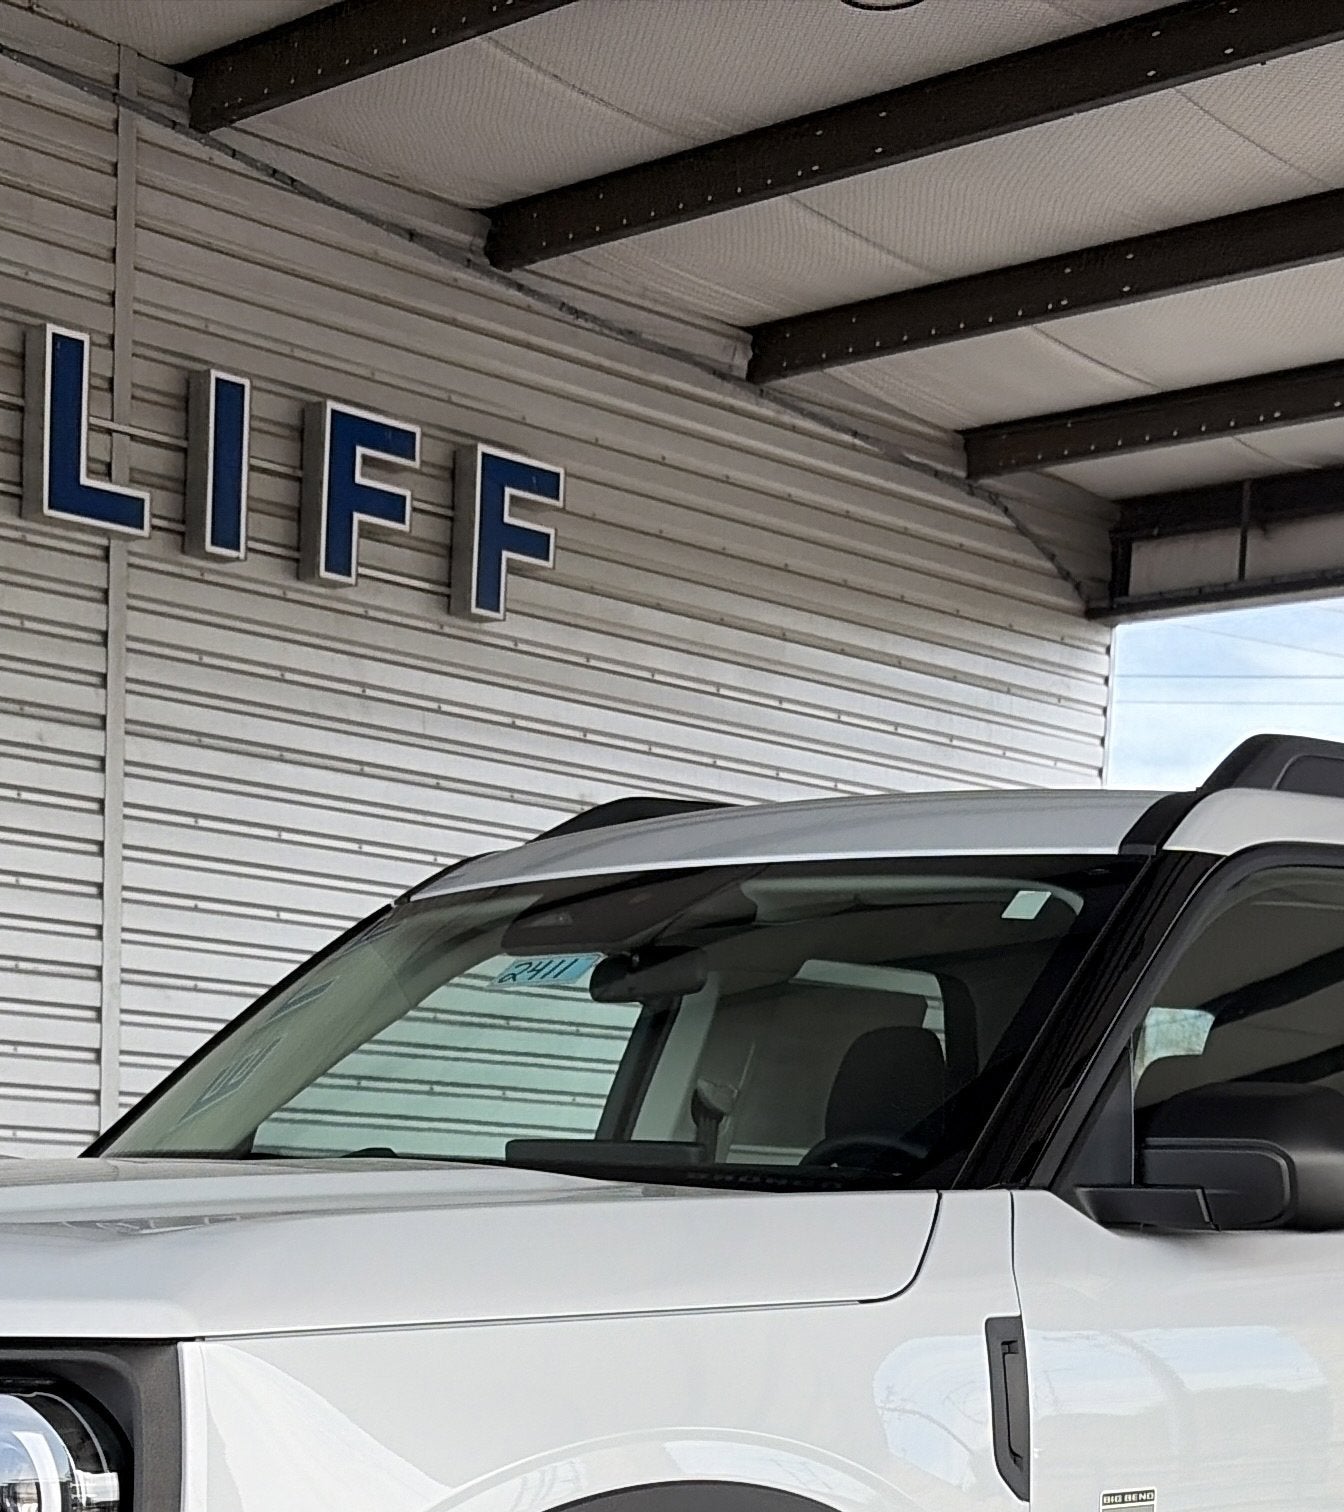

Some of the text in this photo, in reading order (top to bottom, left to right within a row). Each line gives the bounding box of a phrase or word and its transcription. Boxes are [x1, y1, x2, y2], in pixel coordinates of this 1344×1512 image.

[498, 958, 579, 984] 2411
[1103, 1492, 1154, 1504] BIG BEND
